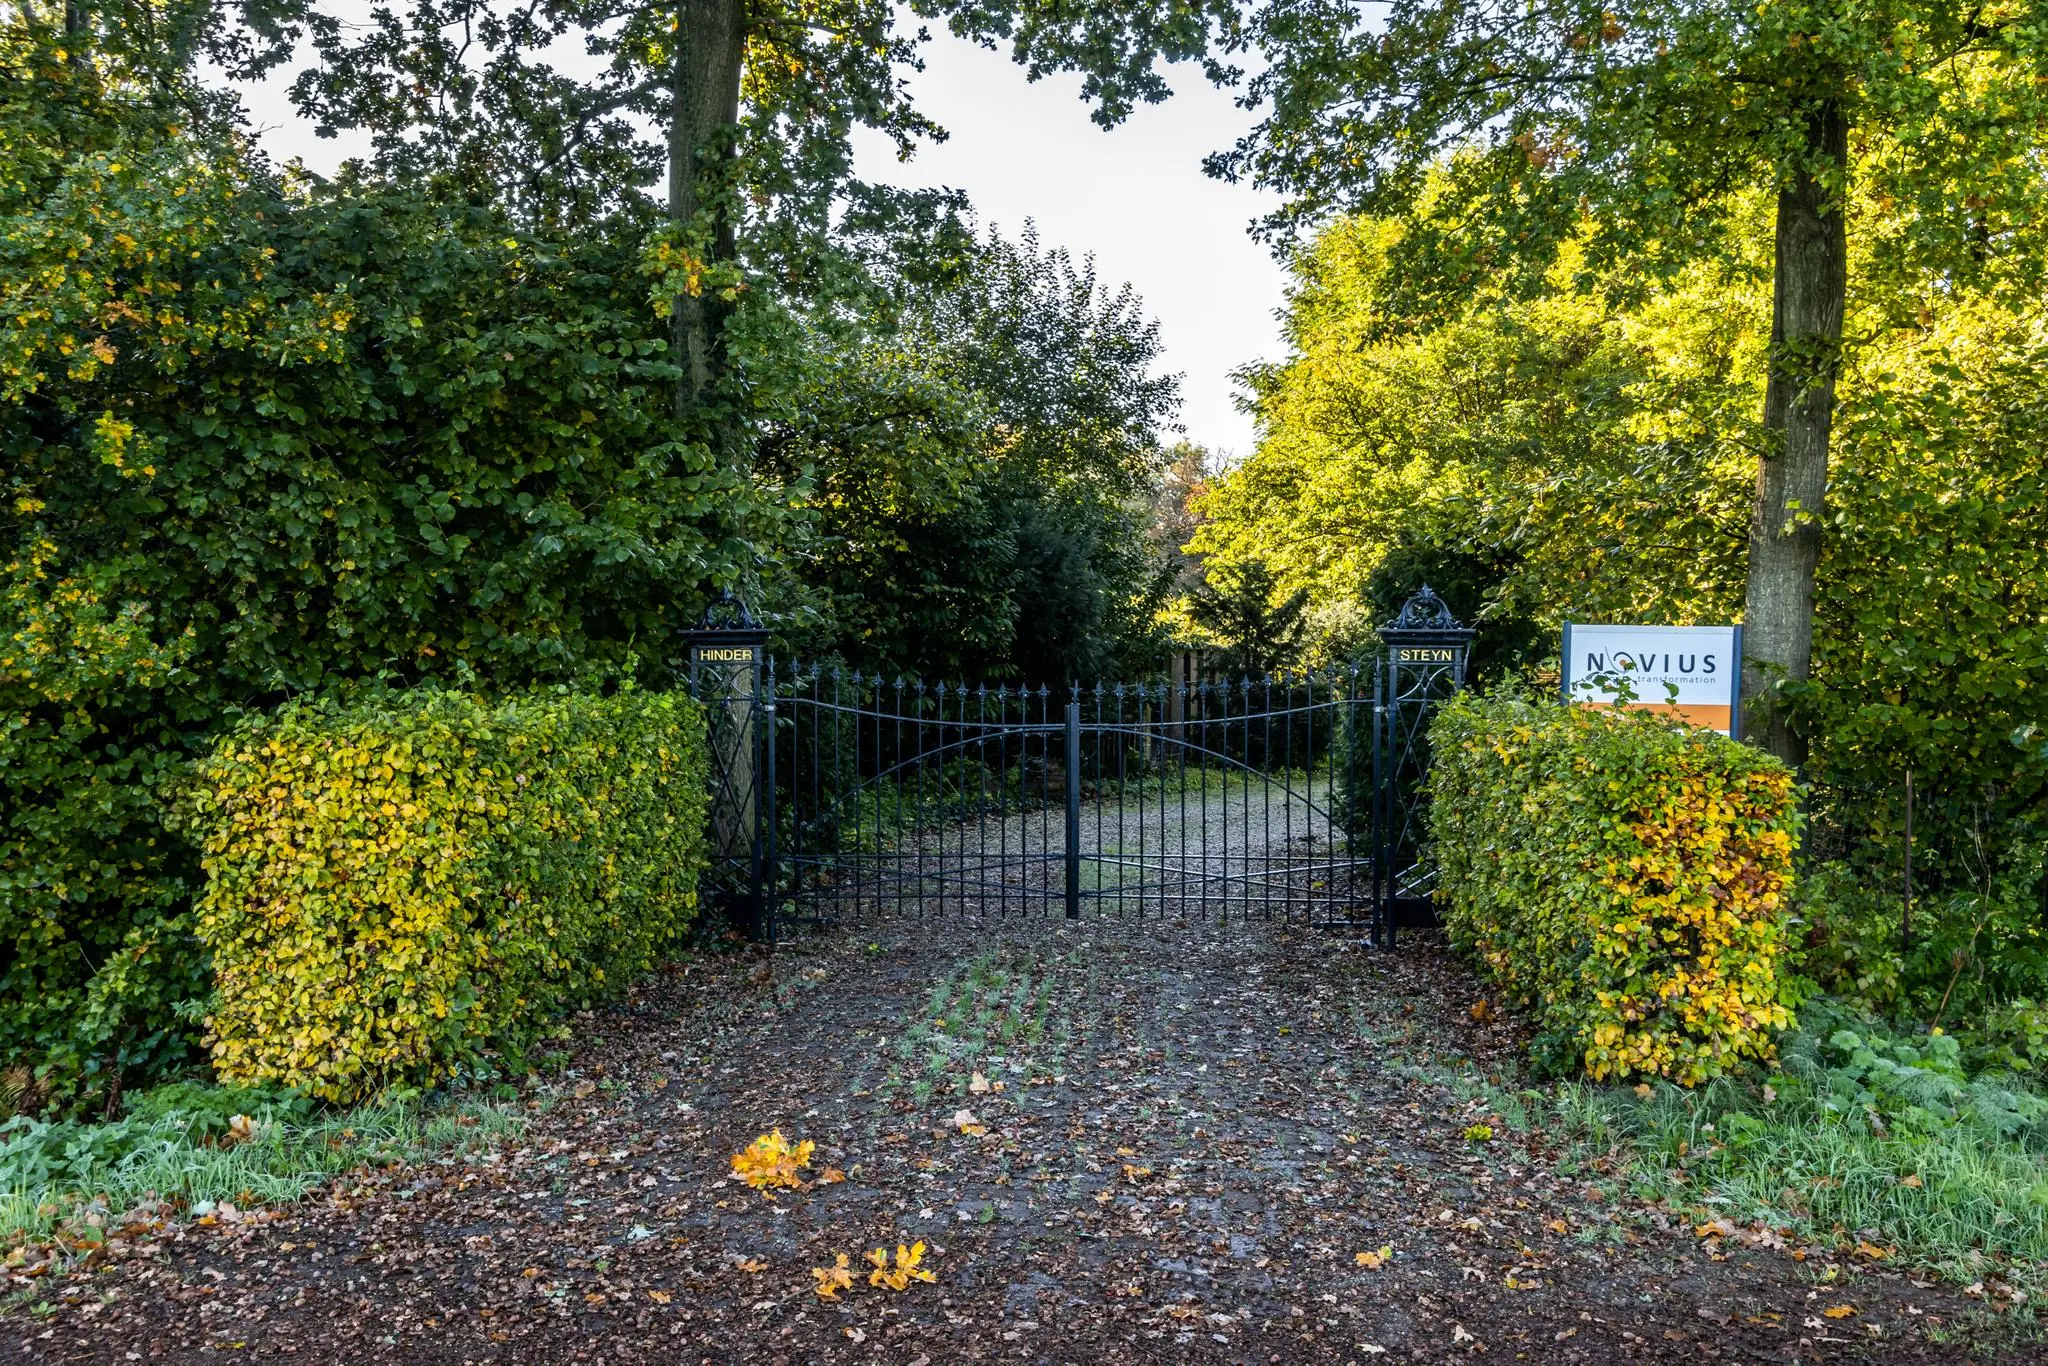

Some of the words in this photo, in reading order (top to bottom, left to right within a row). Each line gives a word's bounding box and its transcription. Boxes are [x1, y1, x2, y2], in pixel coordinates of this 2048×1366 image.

[700, 649, 753, 661] HINDER
[1400, 649, 1452, 661] STEYN
[1587, 650, 1716, 674] NOVIUS
[1637, 674, 1717, 686] transformation
